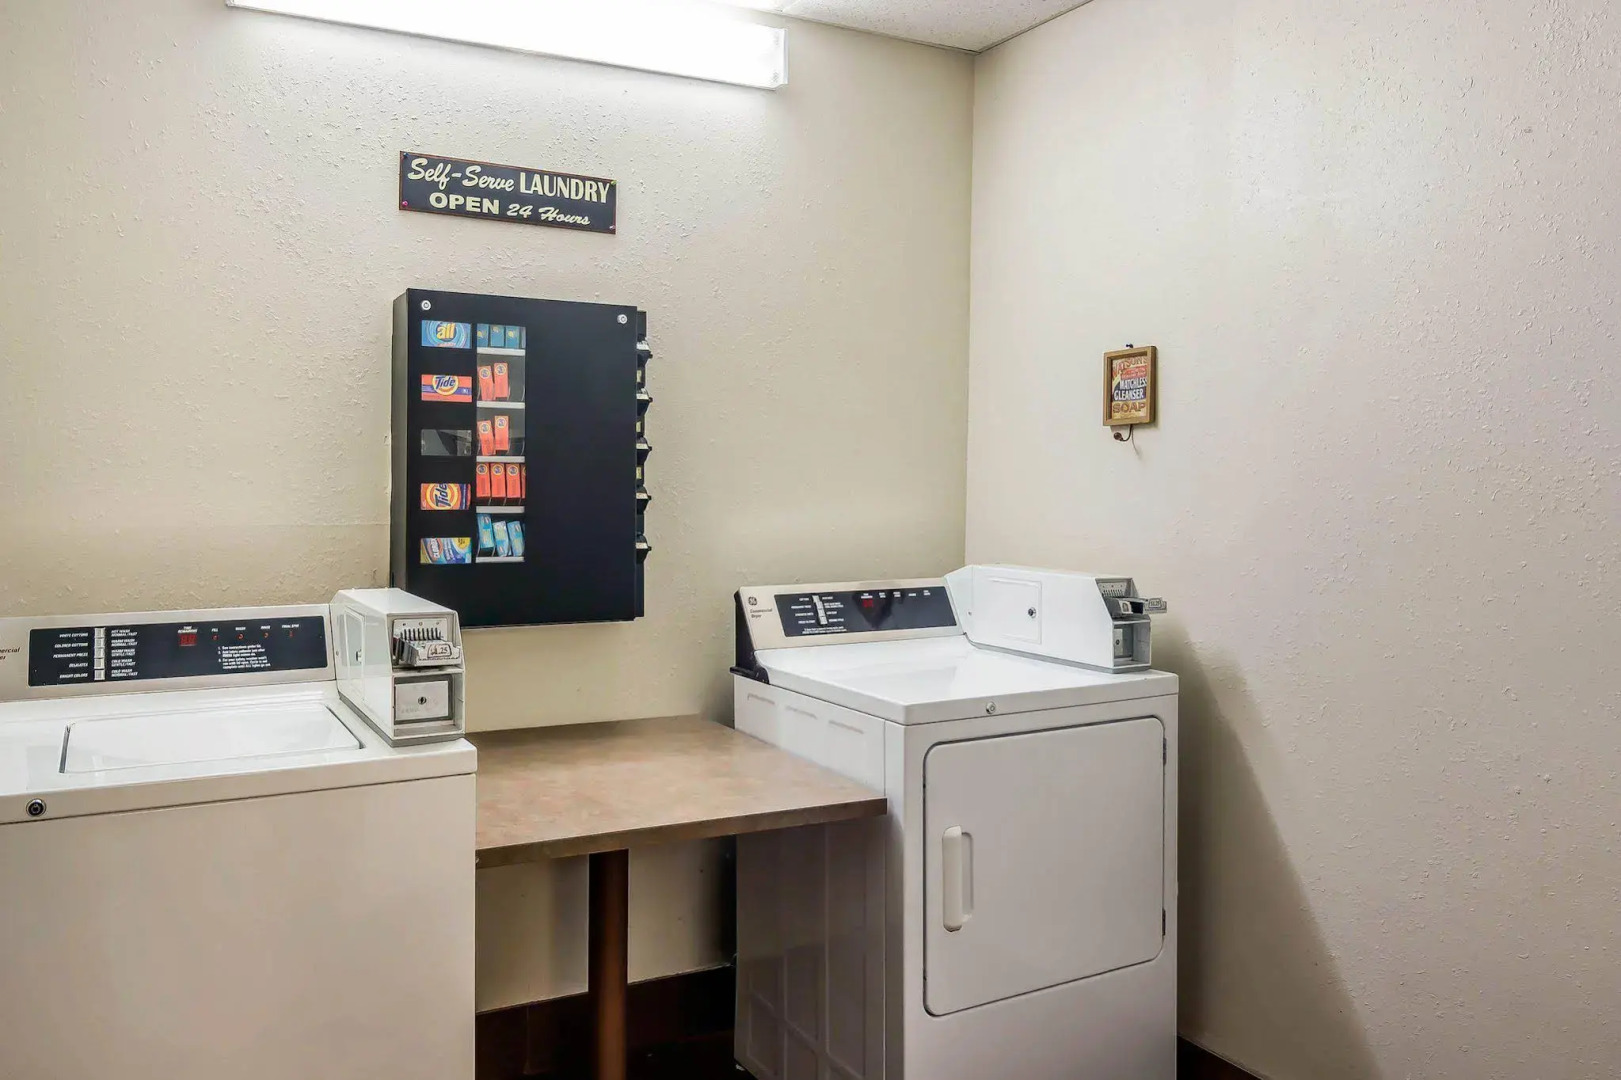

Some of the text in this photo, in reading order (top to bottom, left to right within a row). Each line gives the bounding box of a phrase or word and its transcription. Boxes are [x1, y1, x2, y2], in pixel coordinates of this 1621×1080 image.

[407, 158, 610, 203] Self-Serve LAUNDRY
[429, 192, 591, 225] OPEN 24 Hours
[436, 323, 456, 339] all
[435, 376, 456, 390] Tide
[1114, 389, 1144, 400] CLEANSER
[1113, 402, 1145, 413] SOAP
[434, 483, 452, 507] Tide
